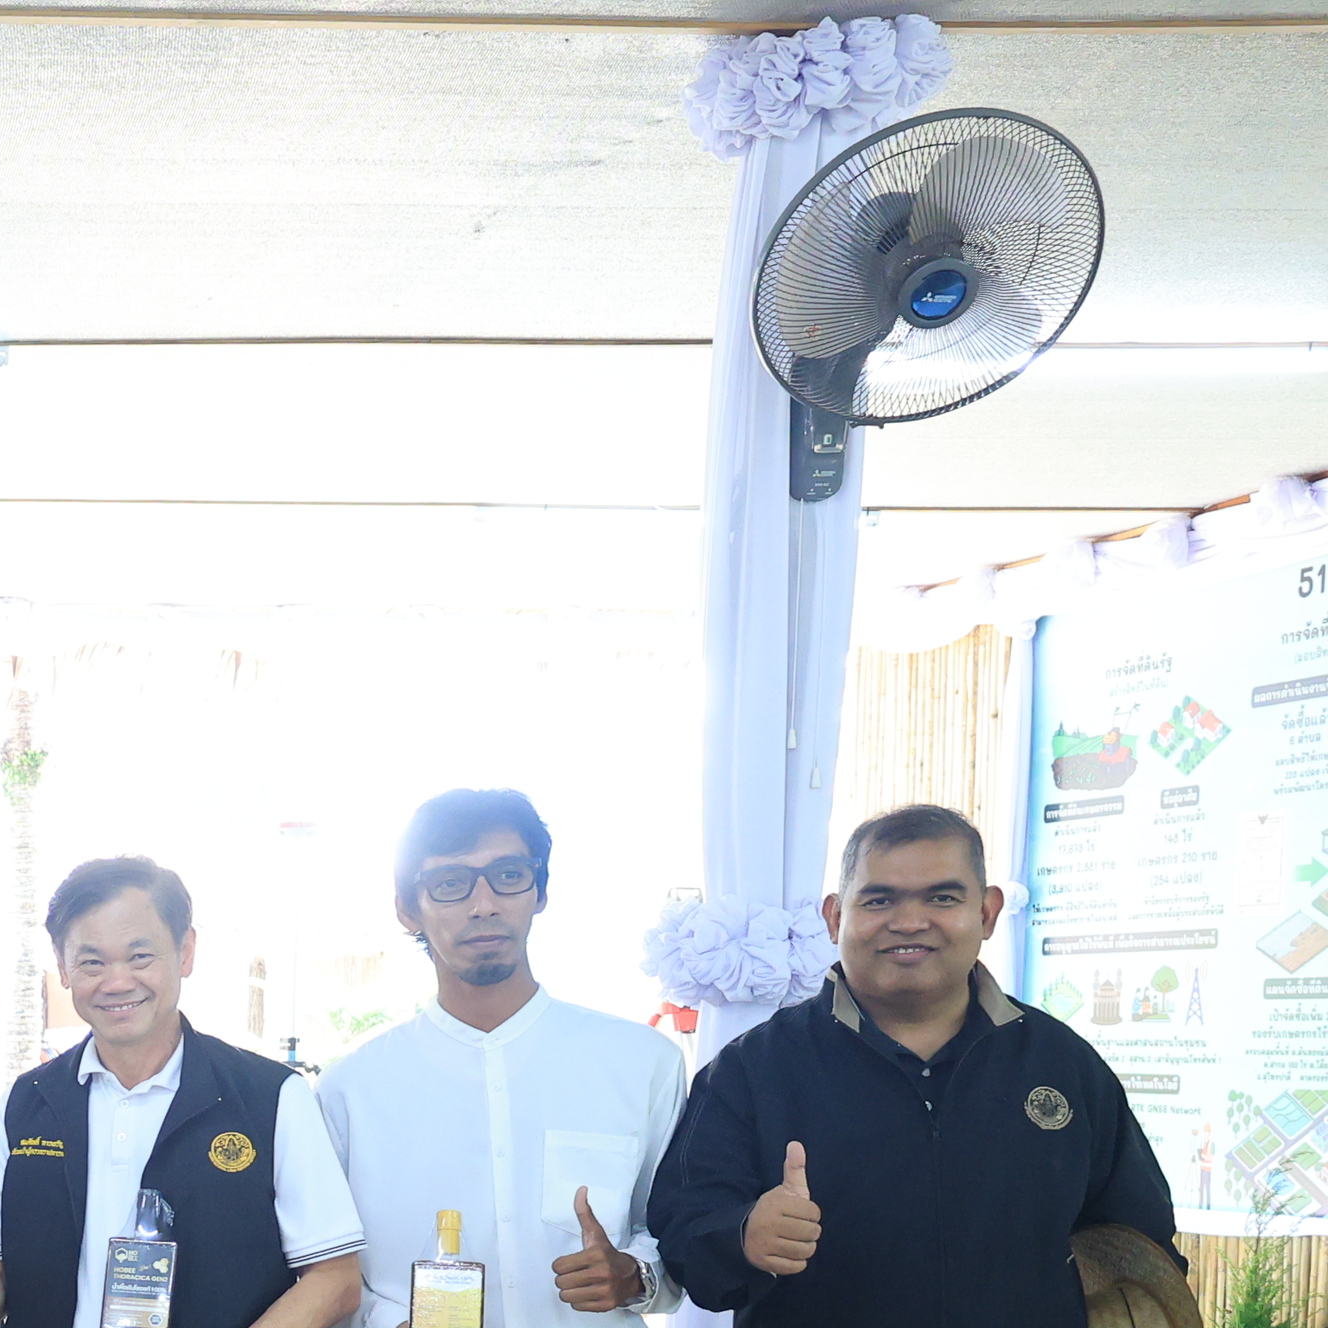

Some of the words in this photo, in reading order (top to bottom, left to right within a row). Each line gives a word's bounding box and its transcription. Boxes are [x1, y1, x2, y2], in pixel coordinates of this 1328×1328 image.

[1254, 678, 1328, 703] ผลการดำเนินงาน
[1281, 704, 1328, 731] จัดซื้อแล้
[1252, 1025, 1328, 1039] รองรับเกษตรกรไร้
